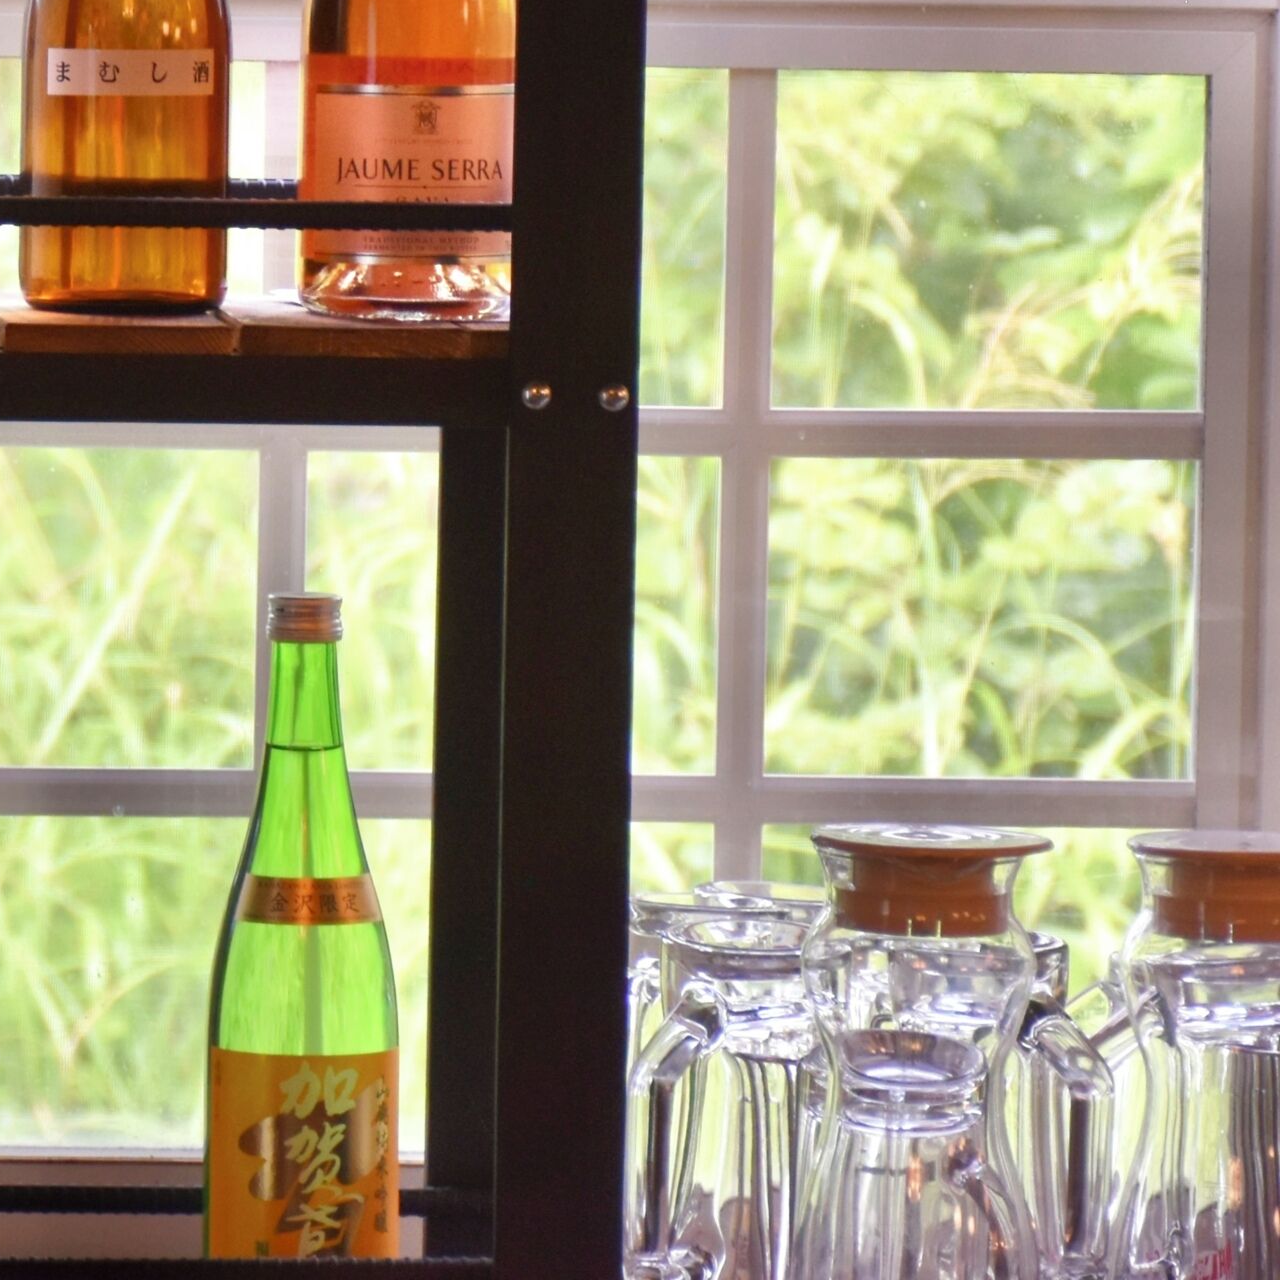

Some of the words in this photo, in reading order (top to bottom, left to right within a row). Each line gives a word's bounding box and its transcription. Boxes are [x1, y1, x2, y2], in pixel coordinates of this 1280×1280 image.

[55, 60, 210, 84] まむし酒
[336, 157, 420, 185] JAUME
[432, 158, 503, 181] SERRA
[270, 891, 361, 915] 金沢限定
